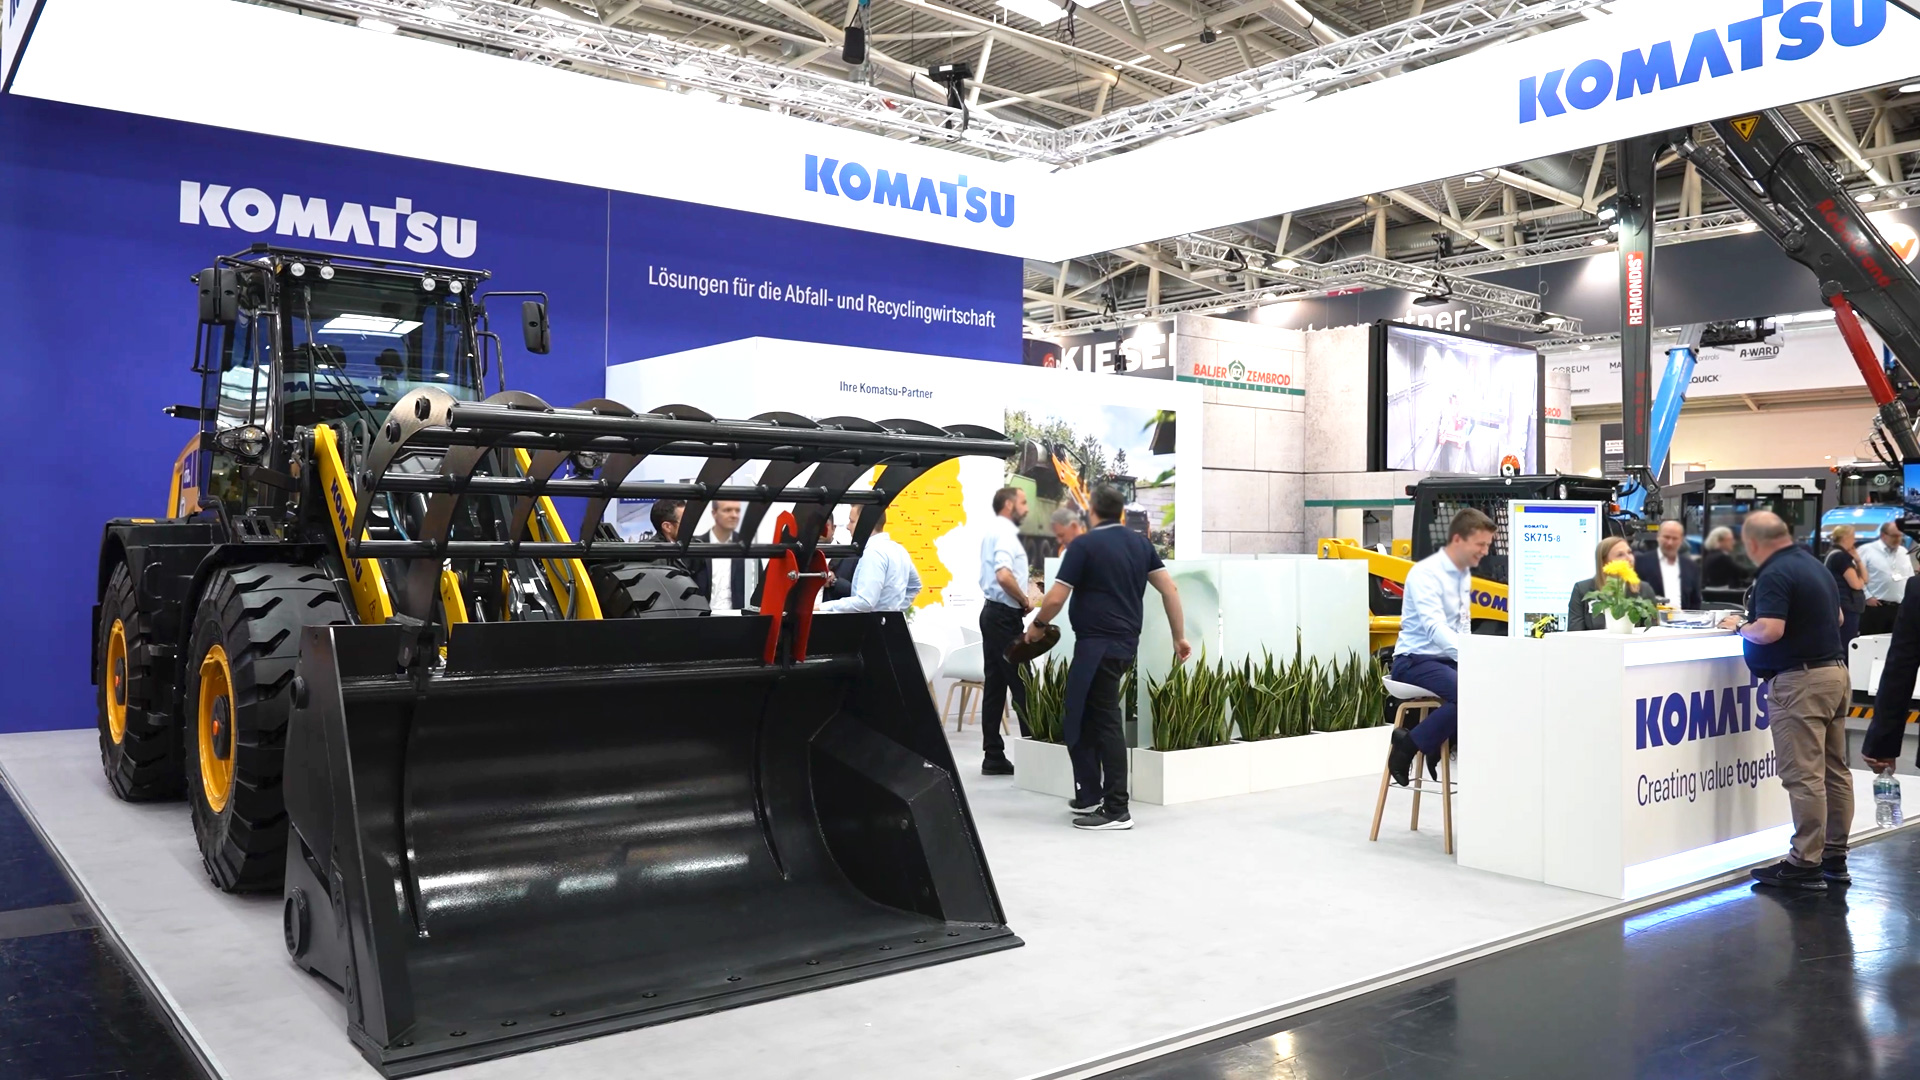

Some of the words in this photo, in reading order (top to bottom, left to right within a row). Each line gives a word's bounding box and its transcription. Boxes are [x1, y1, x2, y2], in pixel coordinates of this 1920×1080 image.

[1519, 0, 1887, 124] KOMATSU
[804, 154, 1016, 229] KOMATSU
[180, 180, 477, 259] KOMATSU
[648, 265, 729, 296] Lösungen
[732, 276, 756, 298] für
[758, 280, 782, 301] die
[784, 283, 834, 307] Abfall-
[837, 293, 864, 312] und
[867, 294, 996, 329] Recyclingwirtschaft
[1696, 353, 1720, 362] ontrols
[1739, 346, 1780, 358] A-WARD
[1193, 363, 1227, 379] BALJER
[1609, 361, 1622, 370] MA
[1246, 370, 1291, 386] ZEMBROD
[840, 381, 858, 393] Ihre
[859, 382, 933, 400] Komatsu-Partner
[1545, 407, 1562, 418] BROD
[1470, 589, 1509, 613] KOM
[1636, 670, 1770, 751] KOMATS
[1637, 768, 1697, 806] Creating
[1699, 761, 1734, 792] value
[1736, 750, 1778, 789] togeth
